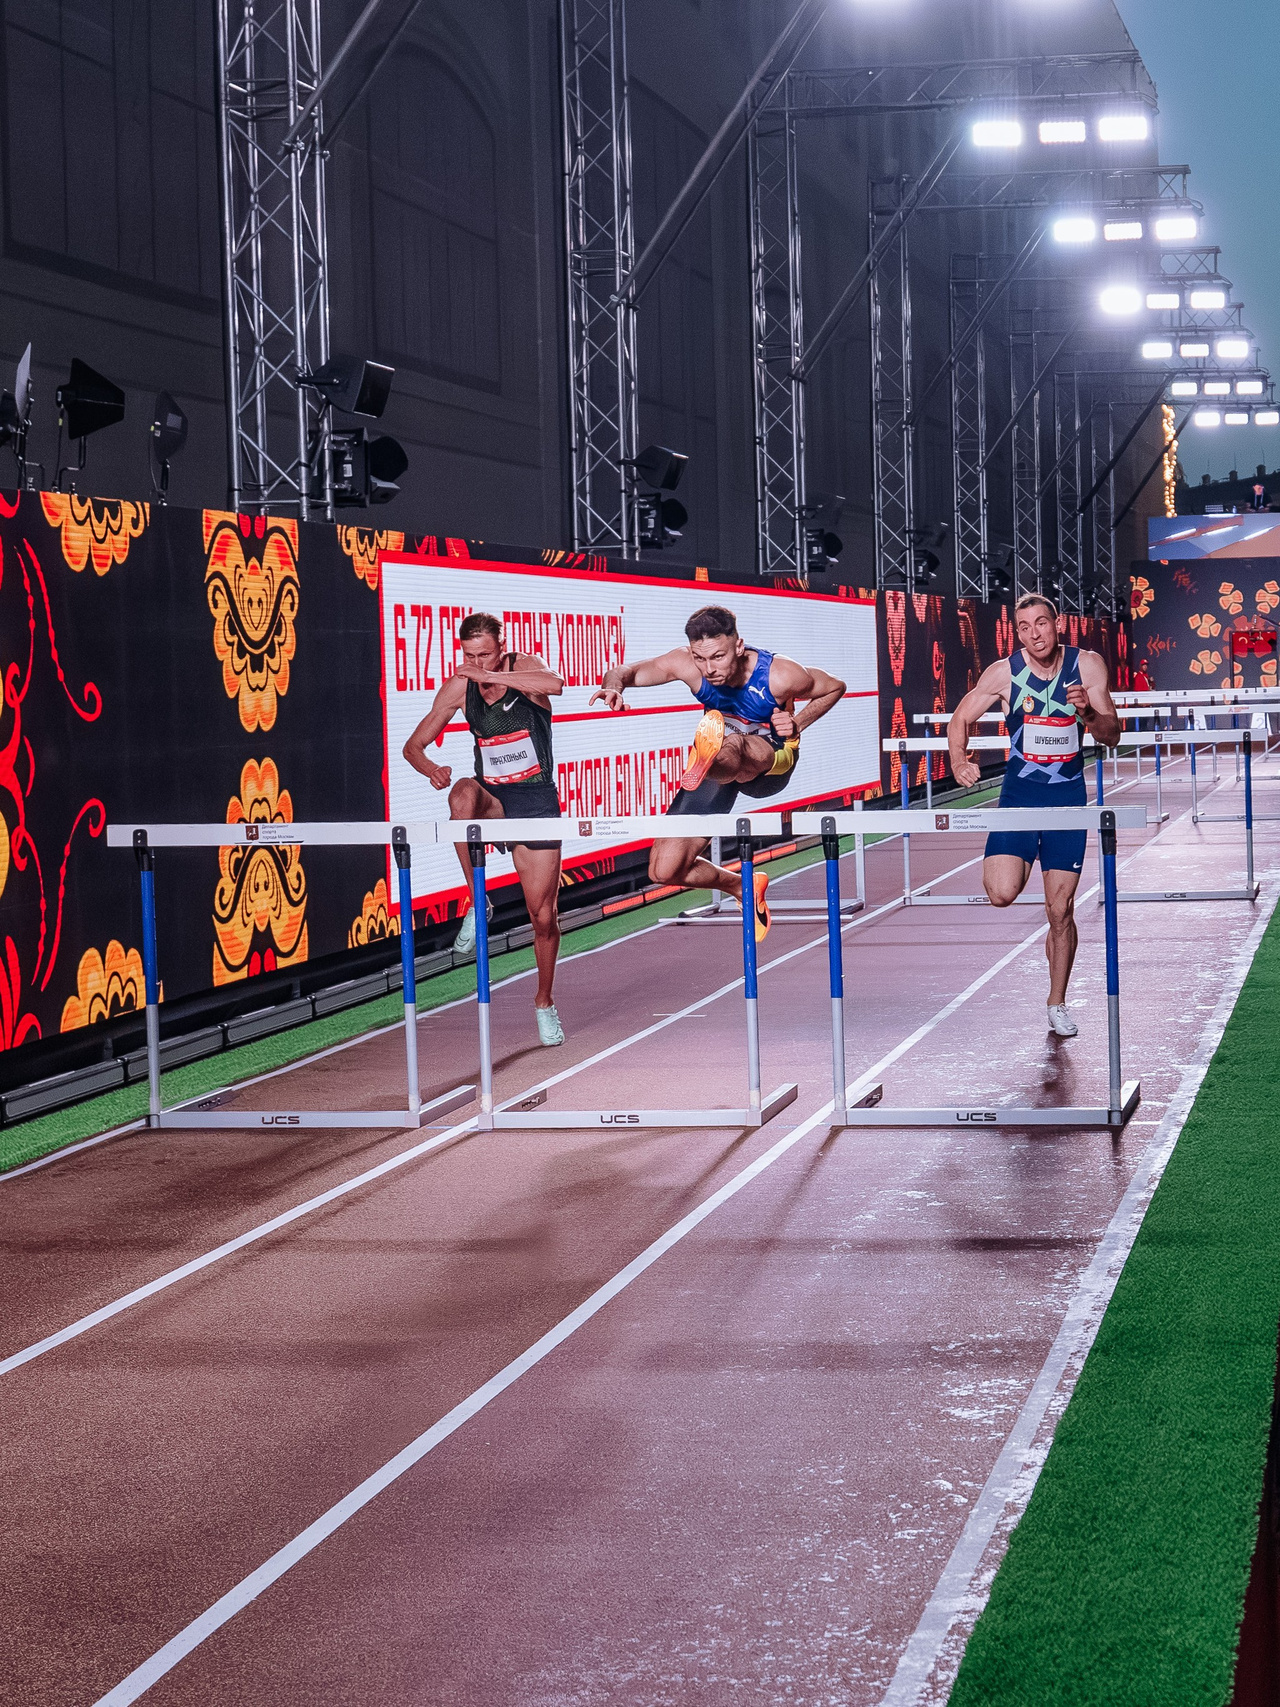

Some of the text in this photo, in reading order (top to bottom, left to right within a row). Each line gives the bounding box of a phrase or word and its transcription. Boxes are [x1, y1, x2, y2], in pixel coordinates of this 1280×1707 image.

[393, 603, 435, 691] 6.72
[439, 605, 473, 684] СЕ
[555, 606, 626, 687] ХОЛЛОУЭЙ
[1034, 735, 1070, 745] ШУБЕНКОВ
[615, 754, 631, 817] 60
[634, 752, 646, 816] М
[649, 750, 656, 816] С
[261, 1116, 300, 1125] UCS
[600, 1114, 640, 1124] UCS
[956, 1112, 997, 1121] UCS
